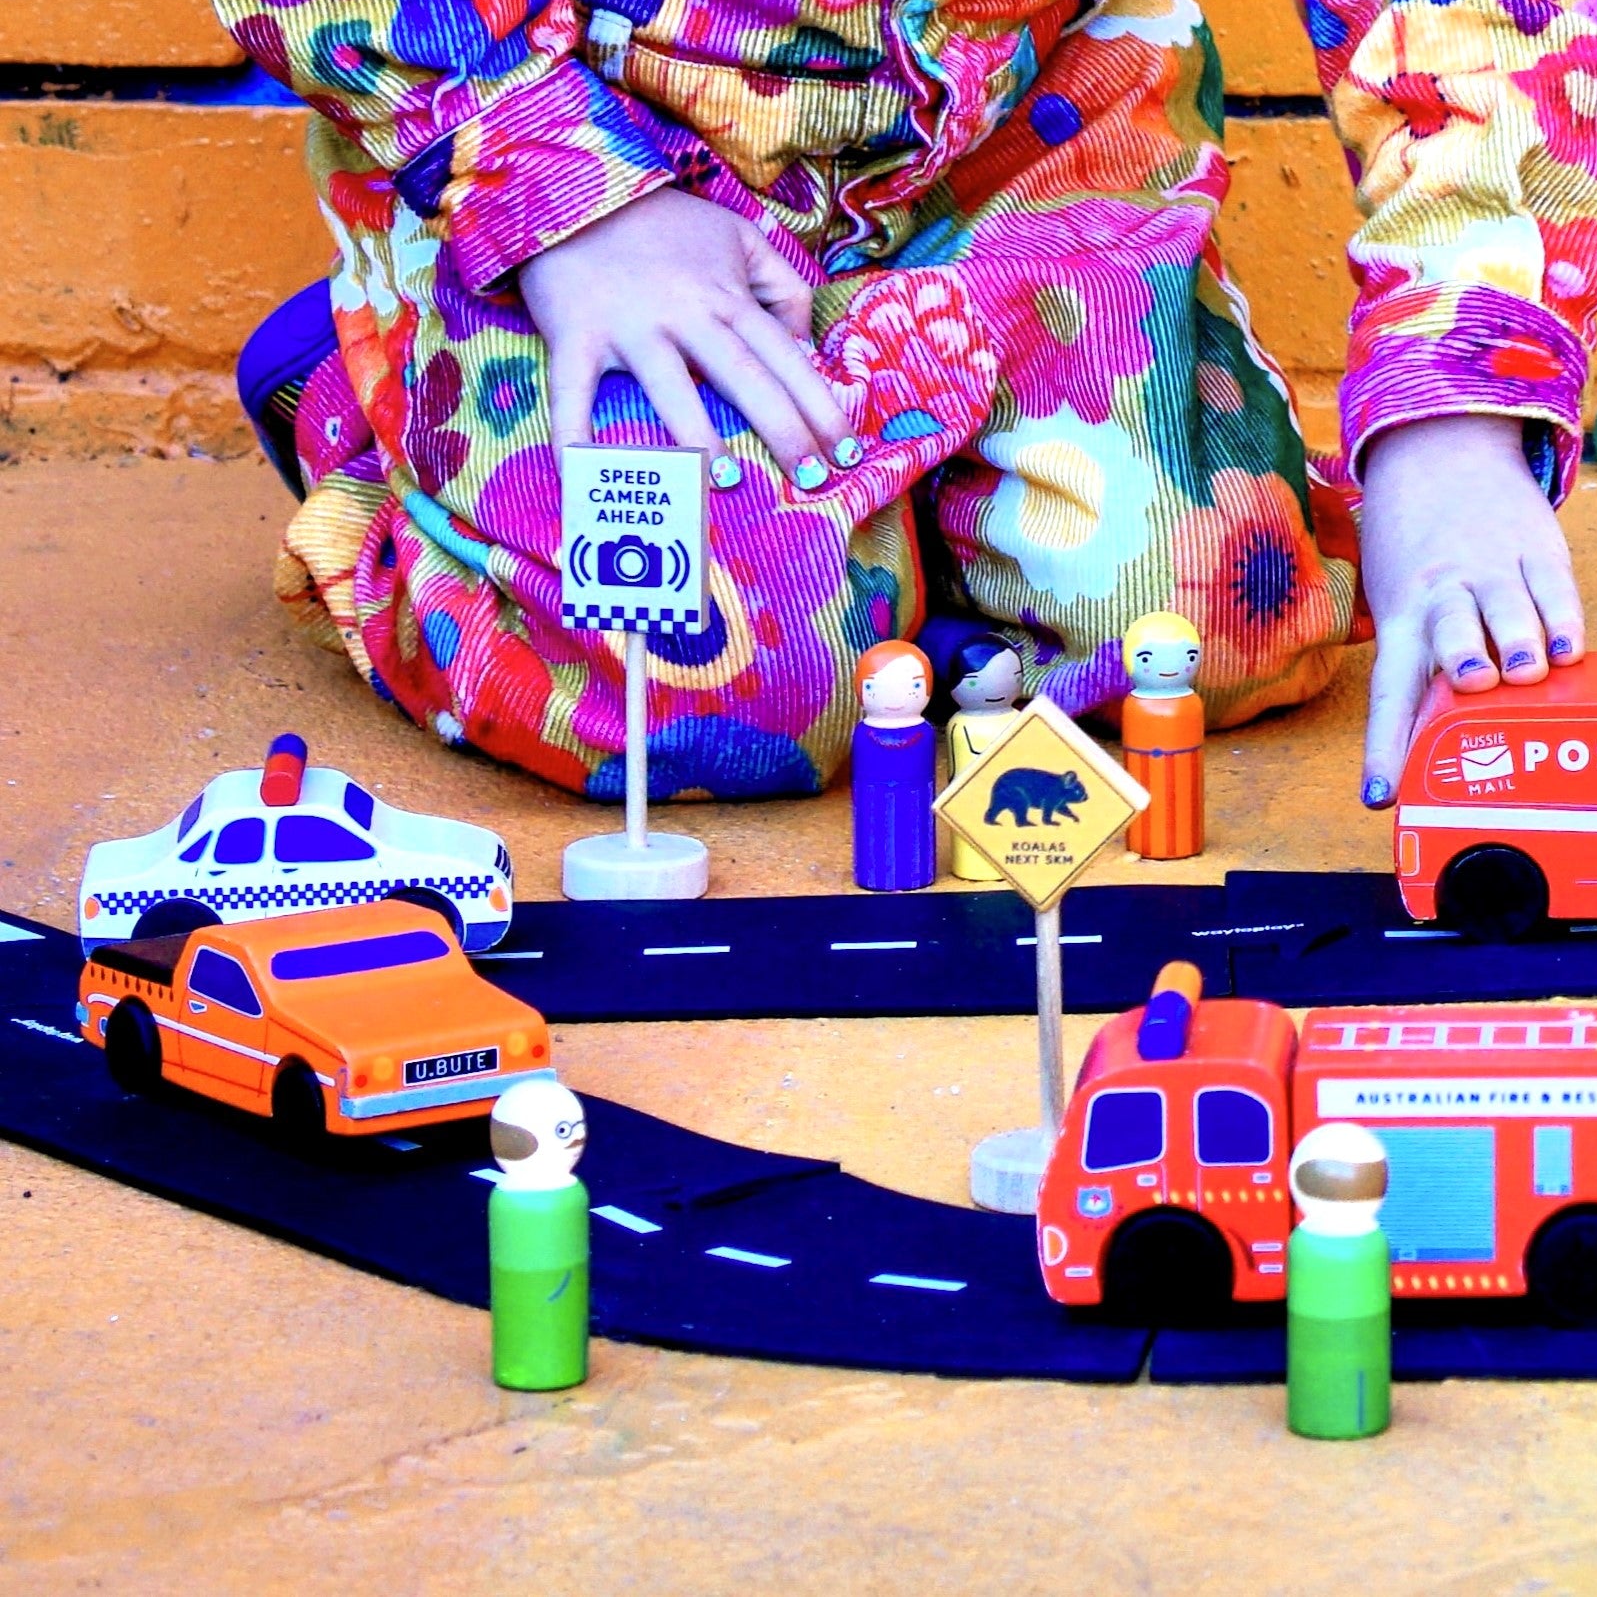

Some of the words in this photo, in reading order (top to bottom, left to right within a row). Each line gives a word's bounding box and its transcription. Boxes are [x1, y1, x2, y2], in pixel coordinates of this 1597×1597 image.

[599, 468, 661, 486] SPEED
[588, 488, 672, 506] CAMERA
[596, 508, 664, 526] AHEAD
[1460, 731, 1506, 750] AUSSIE
[1467, 778, 1516, 797] MAIL
[1011, 841, 1067, 852] KOALAS
[1004, 854, 1040, 865] NEXT
[414, 1051, 487, 1080] U.BUTE
[1355, 1091, 1481, 1105] AUSTRALIAN
[1488, 1091, 1530, 1105] FIRE
